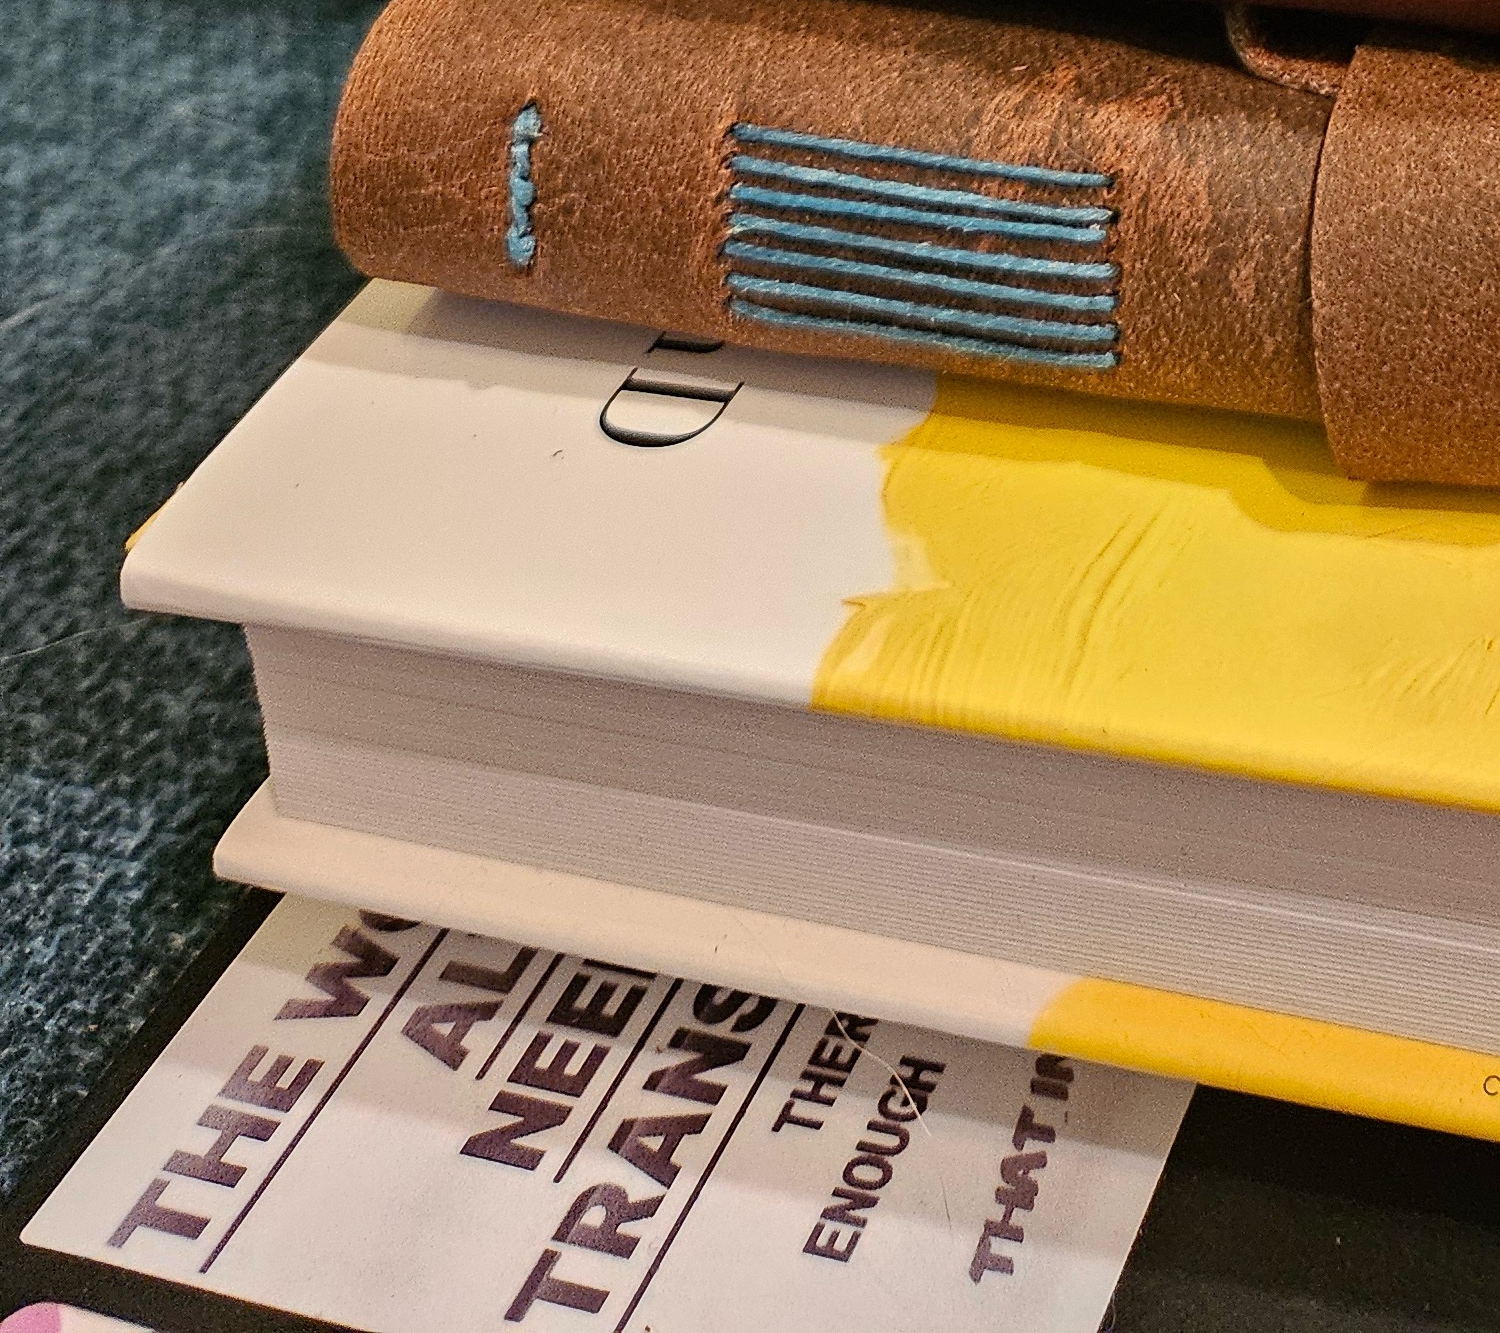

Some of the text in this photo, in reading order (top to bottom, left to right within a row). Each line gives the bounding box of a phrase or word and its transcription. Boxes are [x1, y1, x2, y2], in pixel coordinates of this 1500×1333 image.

[108, 1044, 324, 1249] THE
[459, 959, 658, 1171] NEE
[503, 983, 778, 1322] TRANS
[802, 1055, 946, 1263] ENOUGH
[969, 1103, 1056, 1285] THAT
